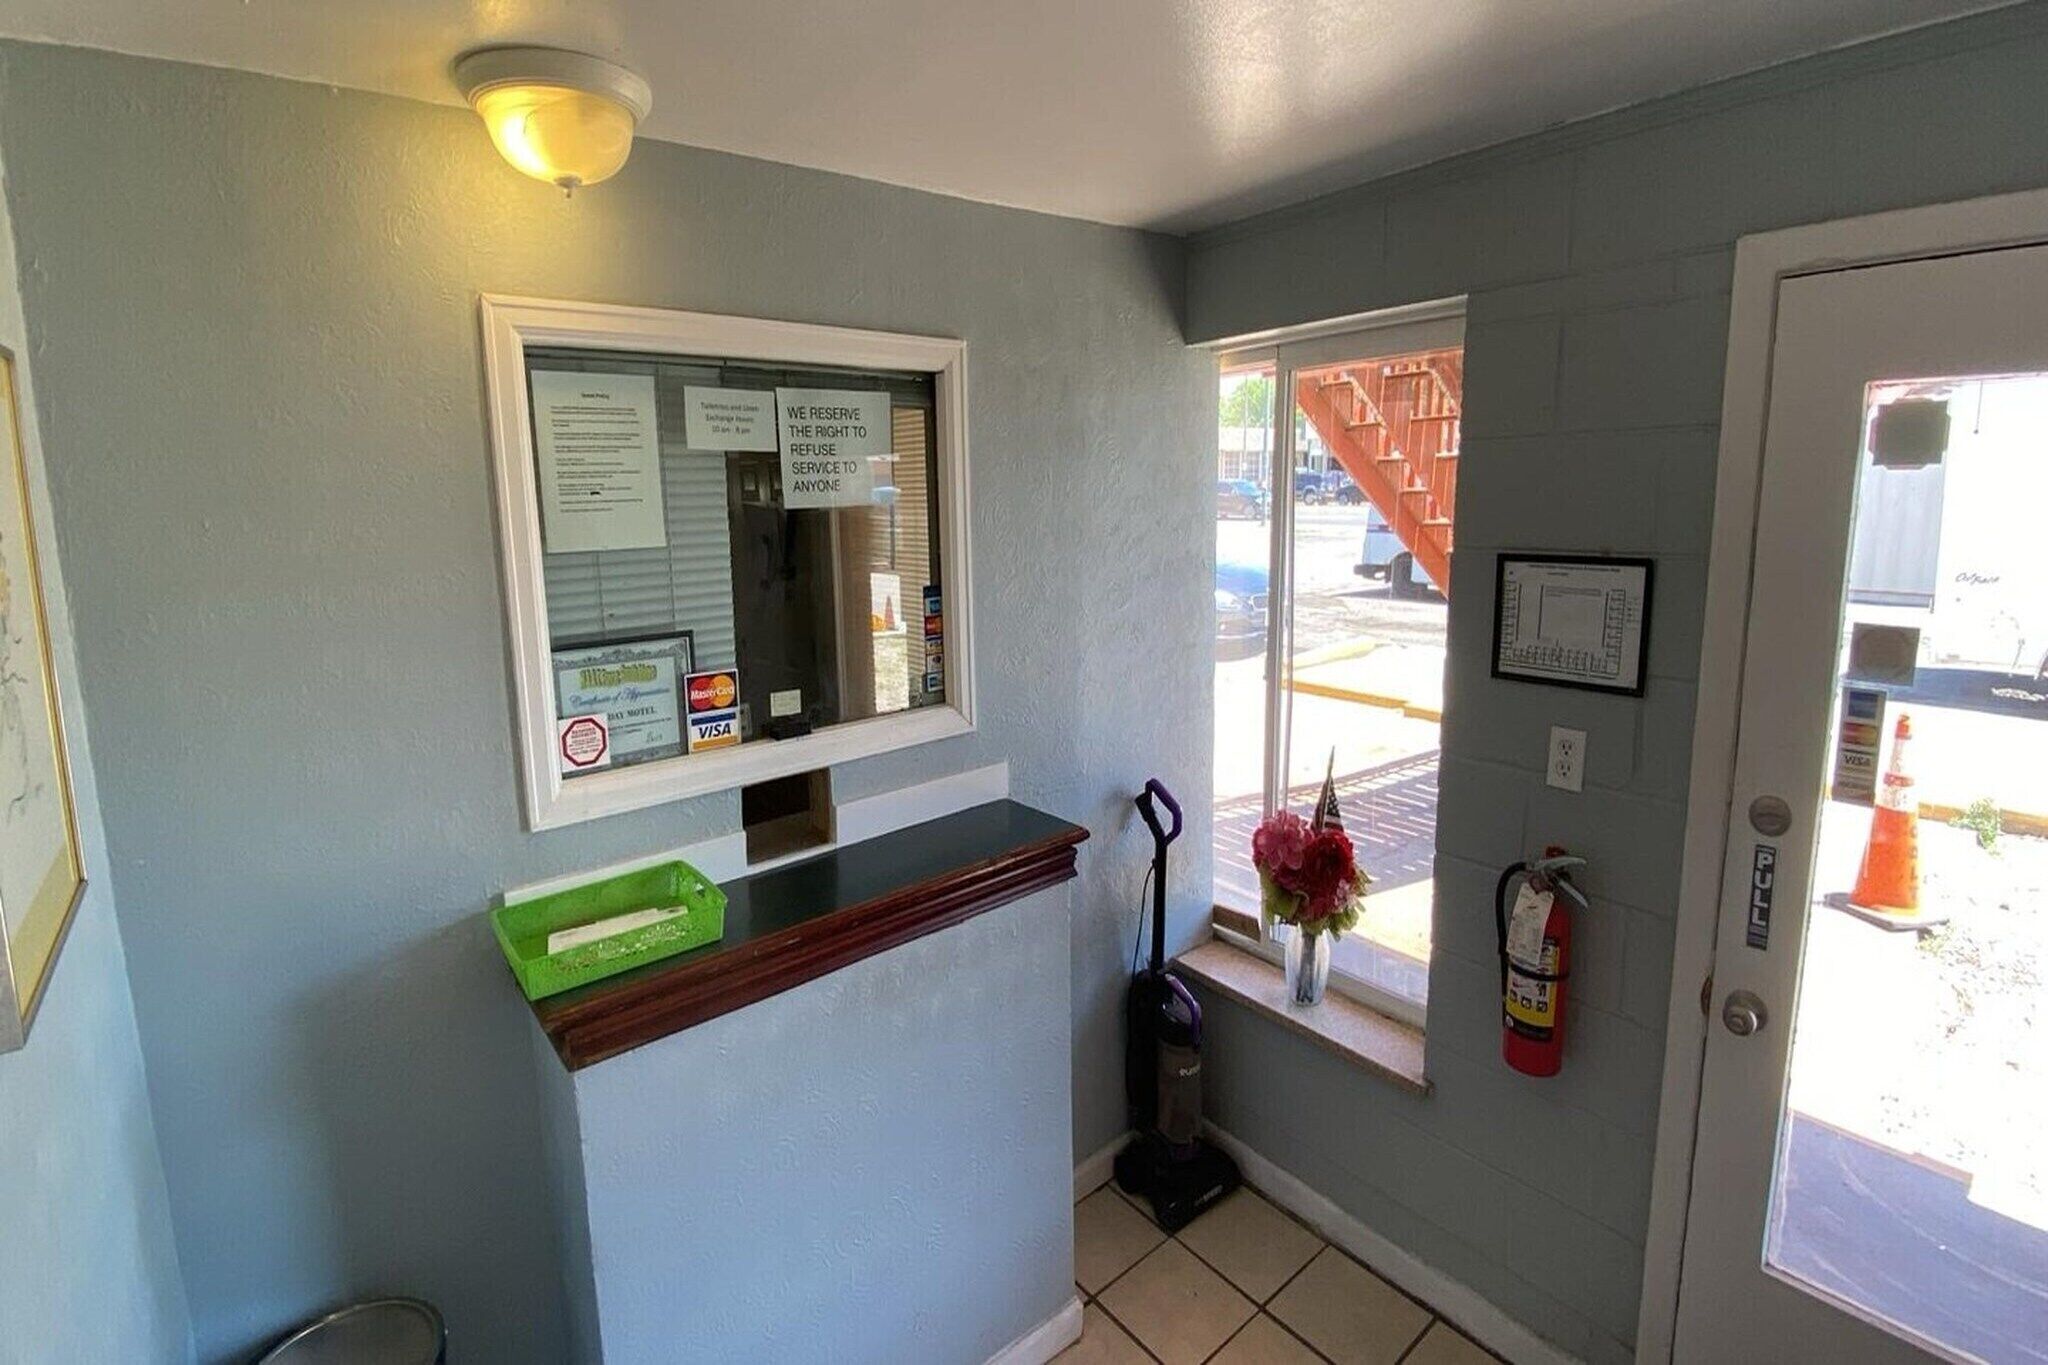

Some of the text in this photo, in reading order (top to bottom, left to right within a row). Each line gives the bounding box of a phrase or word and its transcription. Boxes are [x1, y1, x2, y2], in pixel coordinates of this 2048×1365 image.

[787, 406, 860, 421] WE RESERVE
[789, 425, 867, 438] THE RIGHT TO
[790, 443, 837, 456] REFUSE
[792, 461, 857, 475] SERVICE TO
[793, 479, 841, 493] ANYONE
[690, 687, 735, 700] MasterCard
[627, 706, 657, 717] MOTEL
[698, 722, 732, 739] VISA
[1751, 850, 1774, 926] PULL
